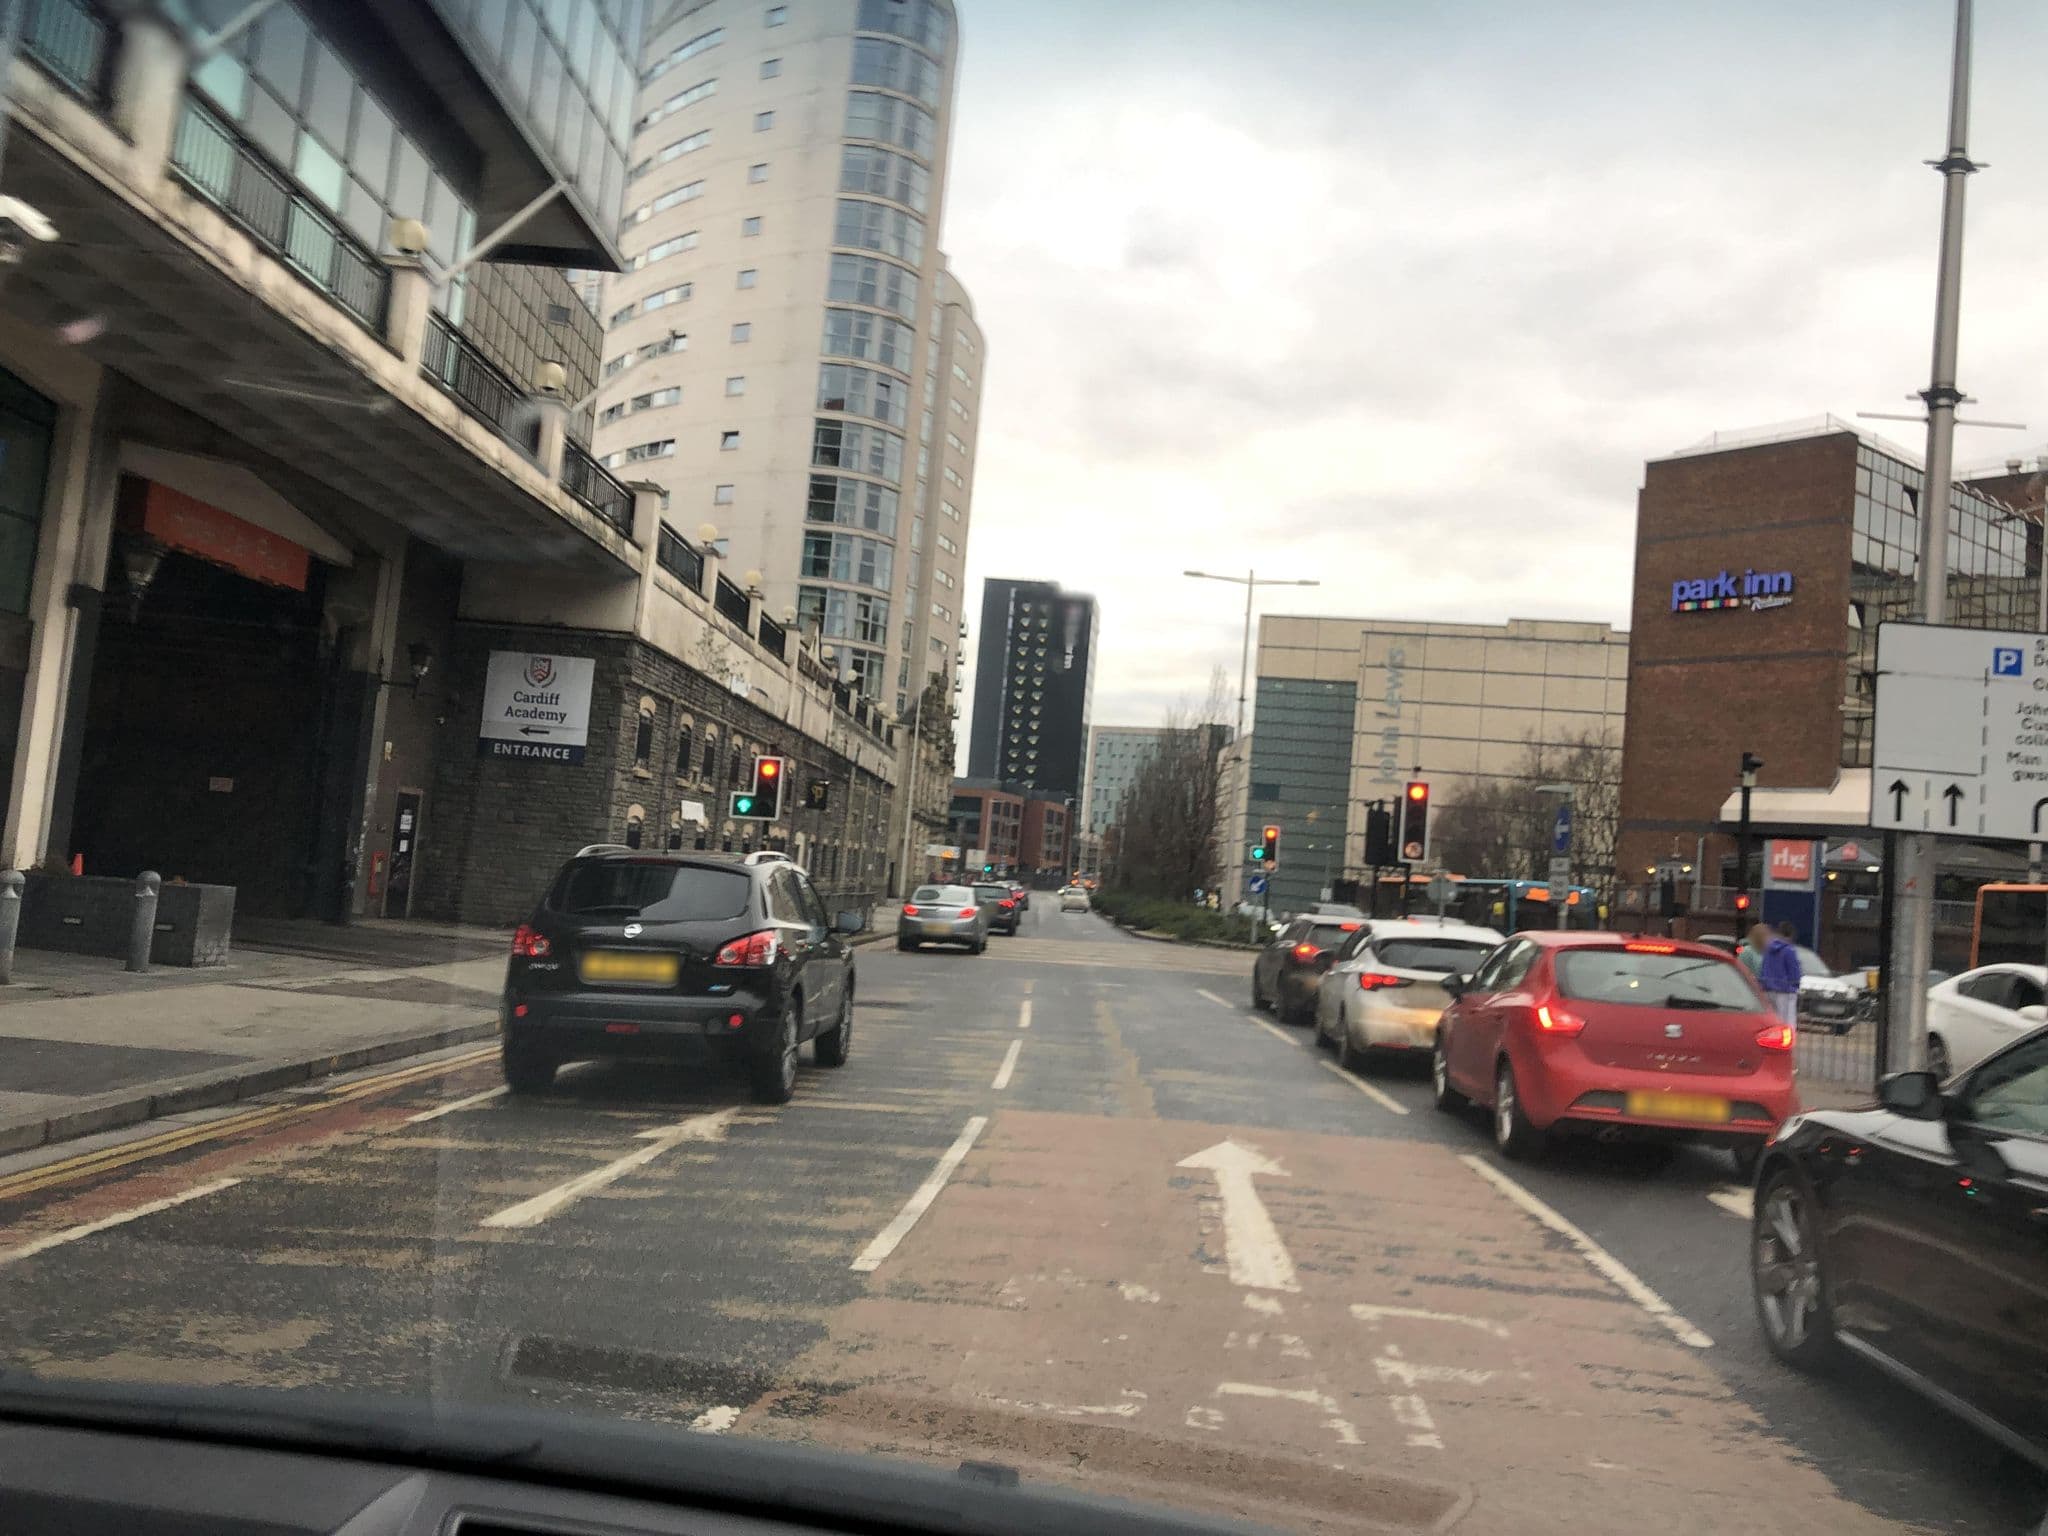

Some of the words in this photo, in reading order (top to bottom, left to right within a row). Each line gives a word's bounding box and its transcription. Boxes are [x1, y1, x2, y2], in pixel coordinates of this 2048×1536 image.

[1672, 571, 1738, 611] park
[1744, 569, 1792, 595] inn
[513, 691, 560, 706] Cardiff
[504, 706, 567, 724] Academy
[493, 743, 570, 760] ENTRANCE
[1370, 726, 1402, 784] John
